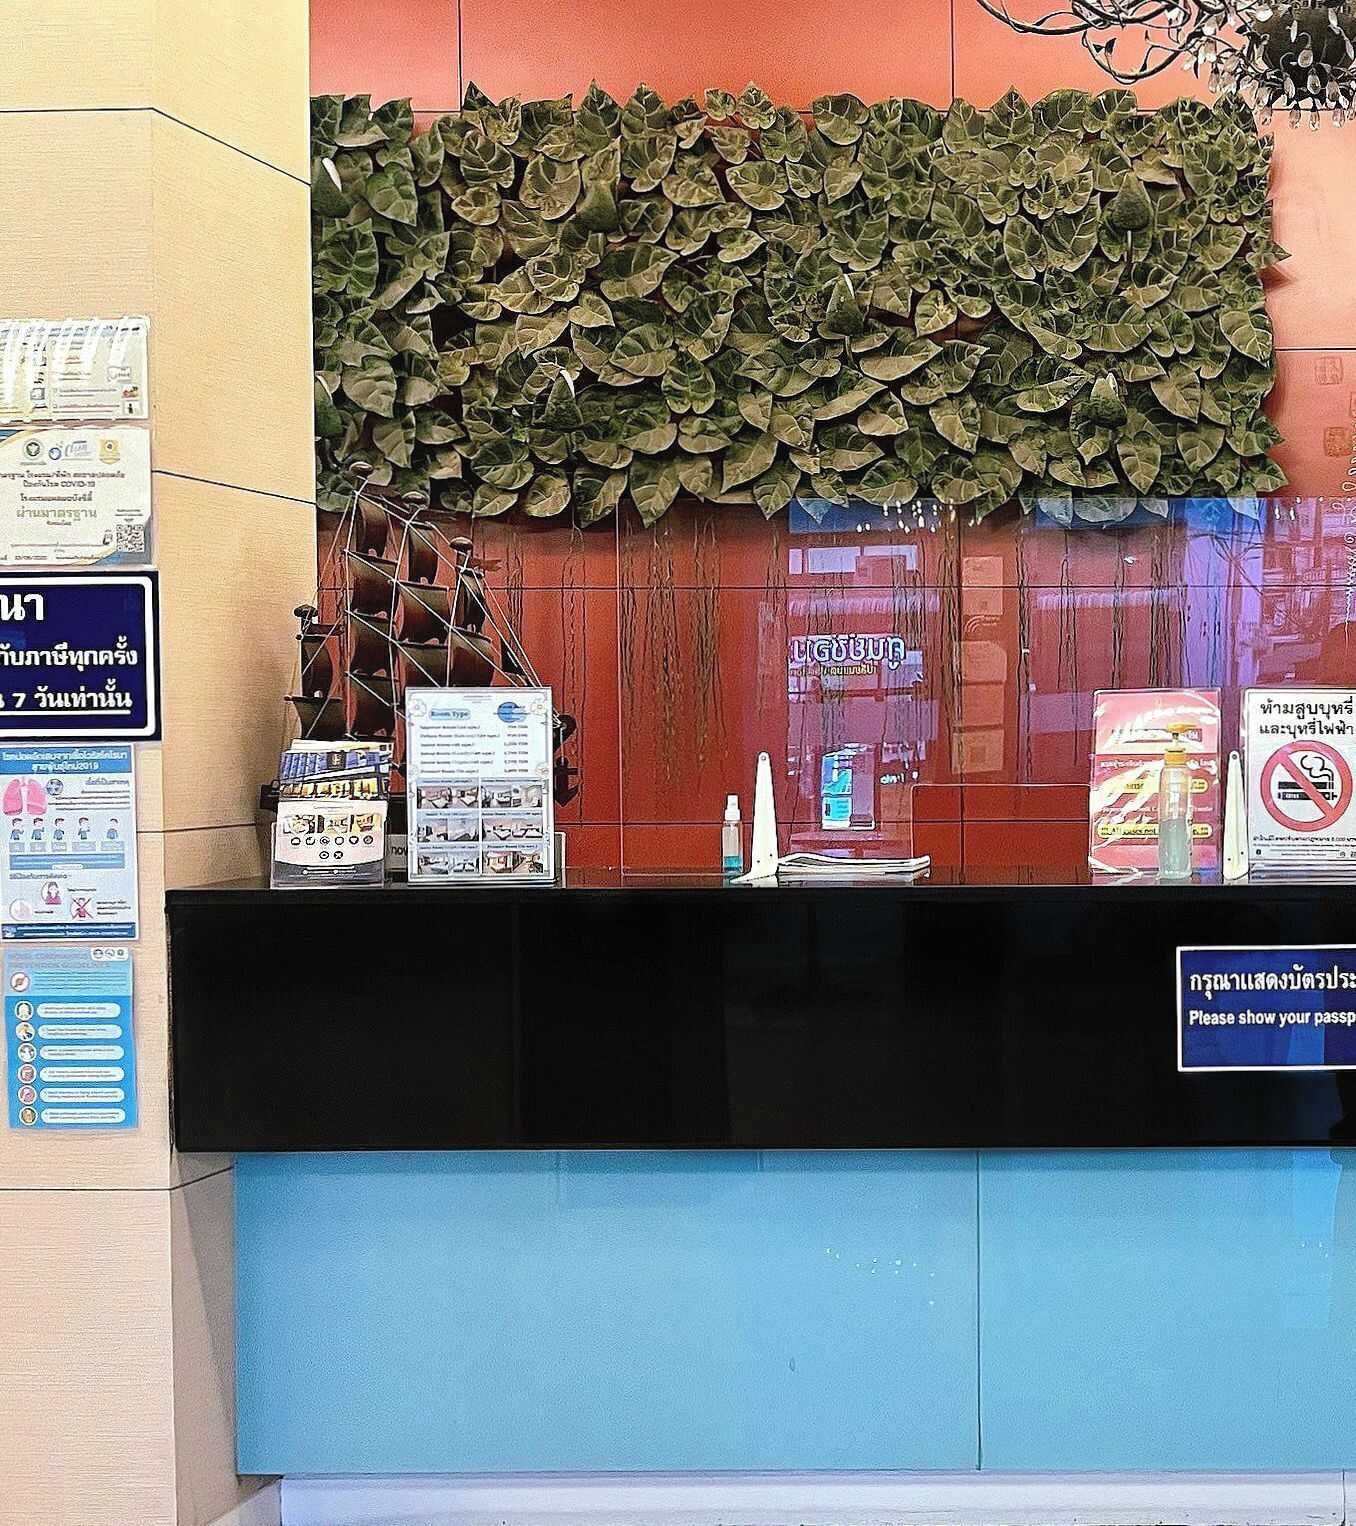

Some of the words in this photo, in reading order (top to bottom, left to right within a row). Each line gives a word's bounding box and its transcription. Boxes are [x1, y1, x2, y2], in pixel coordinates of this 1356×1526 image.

[12, 692, 26, 708] 7
[33, 678, 133, 708] วันเท่านั้น
[1259, 696, 1353, 720] ห้ามสูบบุหรี่
[1259, 718, 1354, 738] และบุหรี่ไฟฟ้า
[1188, 1009, 1236, 1026] Please
[1238, 1009, 1277, 1025] show
[1278, 1011, 1311, 1028] your
